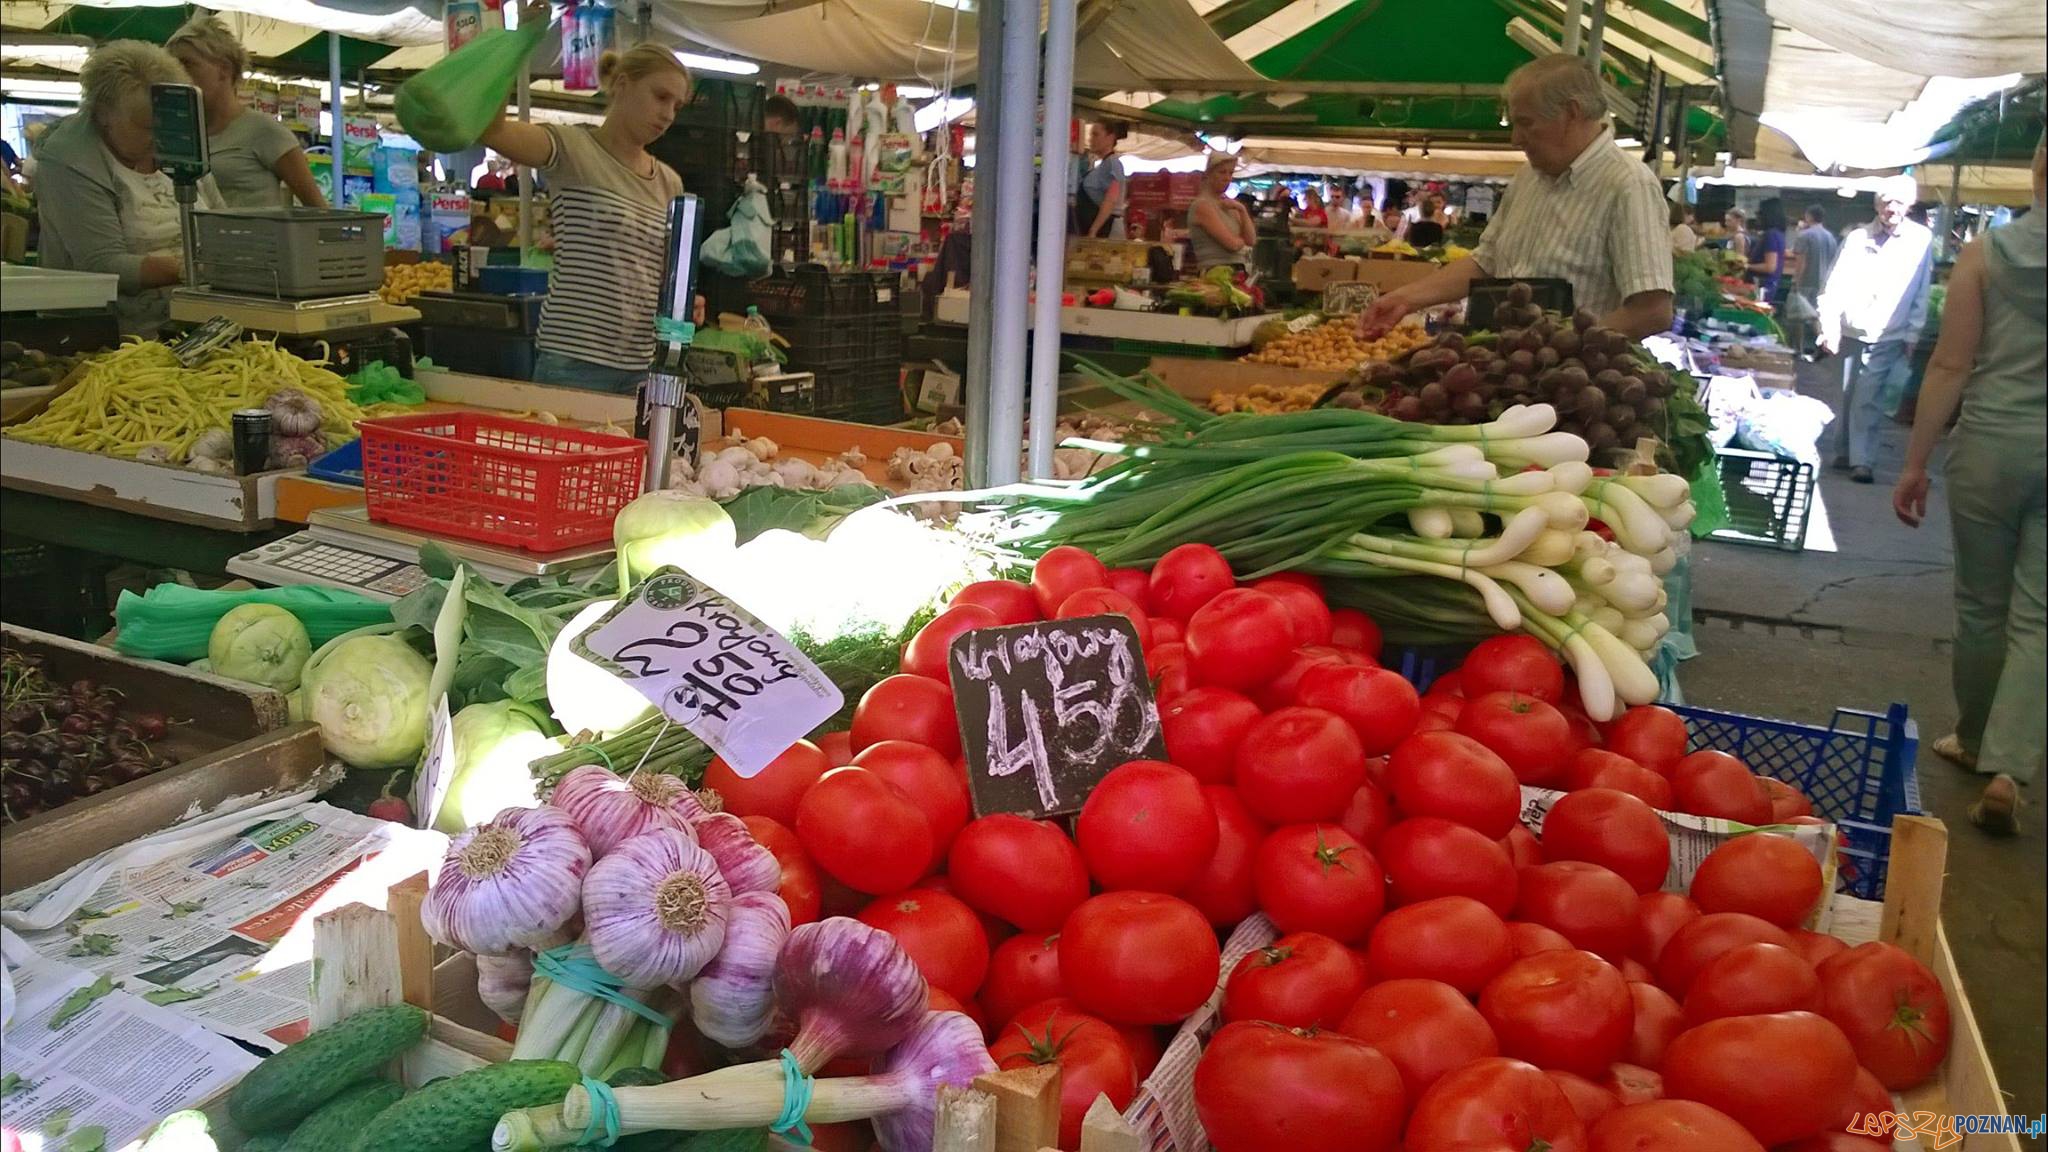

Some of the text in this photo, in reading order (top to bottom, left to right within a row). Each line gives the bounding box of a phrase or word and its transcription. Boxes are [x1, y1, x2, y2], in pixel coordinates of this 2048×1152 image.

[345, 122, 377, 140] Persil
[432, 195, 470, 211] Persil
[264, 821, 321, 852] Kredyt
